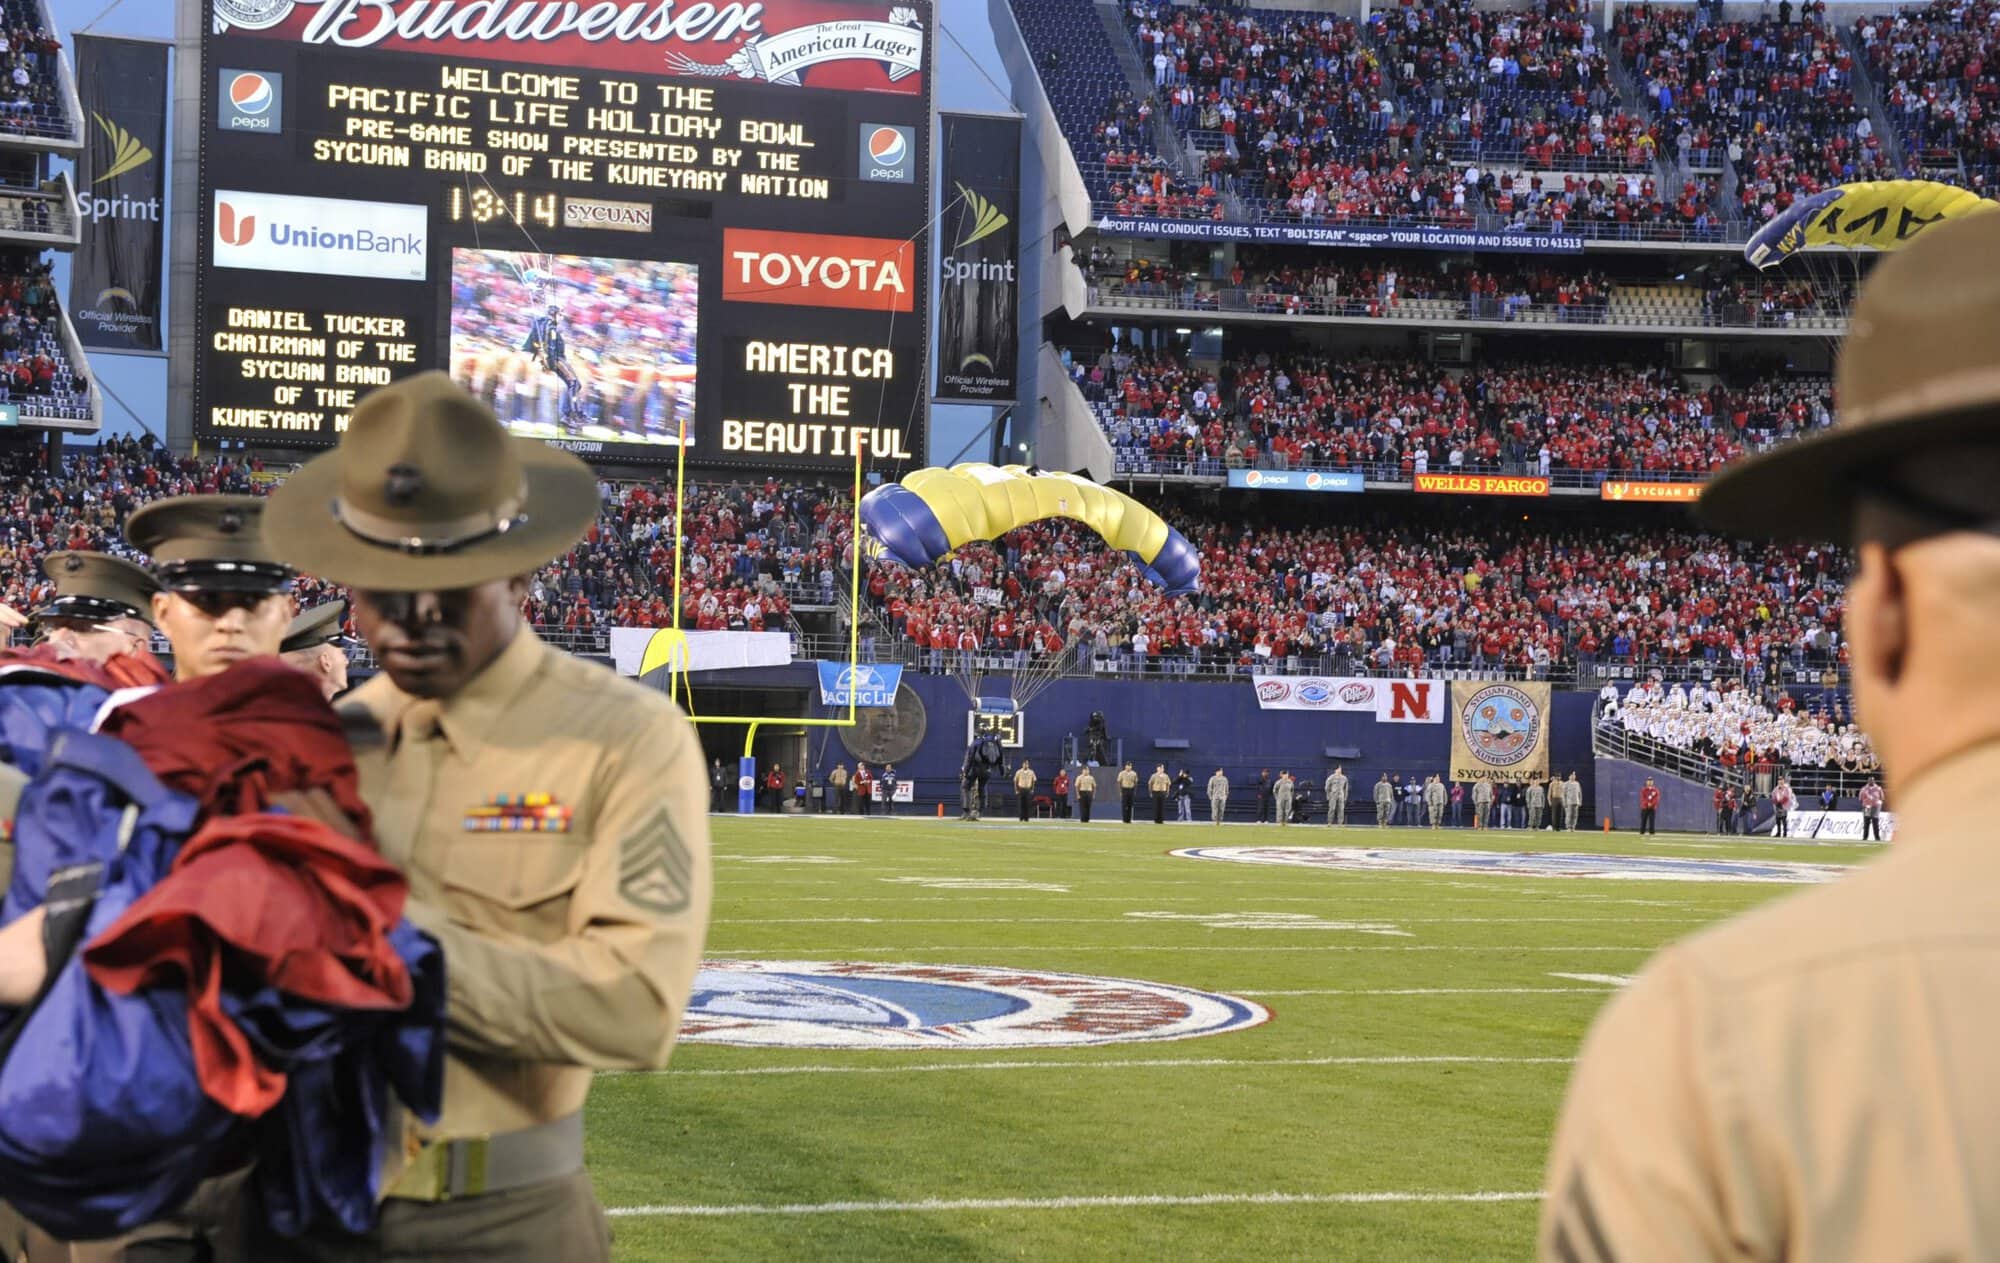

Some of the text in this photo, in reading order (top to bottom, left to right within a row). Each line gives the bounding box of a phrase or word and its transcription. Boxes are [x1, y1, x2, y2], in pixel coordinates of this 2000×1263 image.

[302, 0, 763, 47] Budweiser
[816, 22, 861, 33] The Great
[769, 32, 917, 70] American Lager
[442, 66, 714, 112] WELCOME TO THE
[231, 116, 270, 129] pepsi
[328, 84, 816, 147] PACIFIC LIFE HOLIDAY BOWL
[346, 117, 800, 172] PRE-GAME SHOW PRESENTED BY THE
[314, 140, 829, 199] SYCUAN BAND OF THE KUMEYAAY NATION
[870, 167, 903, 180] pepsi
[77, 191, 160, 224] Sprint
[450, 186, 557, 228] 13:14
[566, 204, 651, 225] SYCUAN
[270, 222, 422, 255] UnionBank
[1138, 222, 1159, 232] FAN
[1161, 223, 1211, 235] CONDUCT
[1213, 225, 1252, 238] ISSUES,
[1254, 227, 1280, 238] TEXT
[1348, 231, 1389, 243] <space>
[1391, 232, 1420, 243] YOUR
[1422, 233, 1475, 245] LOCATION
[1477, 235, 1499, 246] AND
[1502, 236, 1532, 247] ISSUE
[1534, 237, 1549, 247] TO
[1550, 237, 1581, 248] 41513
[733, 251, 905, 293] TOYOTA
[943, 256, 1015, 286] Sprint
[79, 310, 152, 324] Official Wireless
[98, 322, 137, 333] Provider
[228, 308, 405, 337] DANIEL TUCKER
[214, 332, 417, 362] CHAIRMAN OF THE
[746, 341, 893, 379] AMERICA
[241, 359, 391, 385] SYCUAN BAND
[944, 375, 1010, 386] Official Wireless
[274, 386, 356, 408] OF THE
[788, 384, 850, 416] THE
[960, 384, 993, 394] Provider
[211, 407, 324, 431] KUMEYAAY
[722, 420, 912, 459] BEAUTIFUL
[1263, 475, 1289, 485] pepsi
[1322, 478, 1348, 487] pepsi
[1418, 477, 1546, 494] WELLS FARGO
[1633, 487, 1681, 497] SYCUAN
[1391, 683, 1430, 719] N
[1470, 688, 1531, 709] SYCUAN BAND
[1457, 768, 1543, 780] SYCUAN.COM
